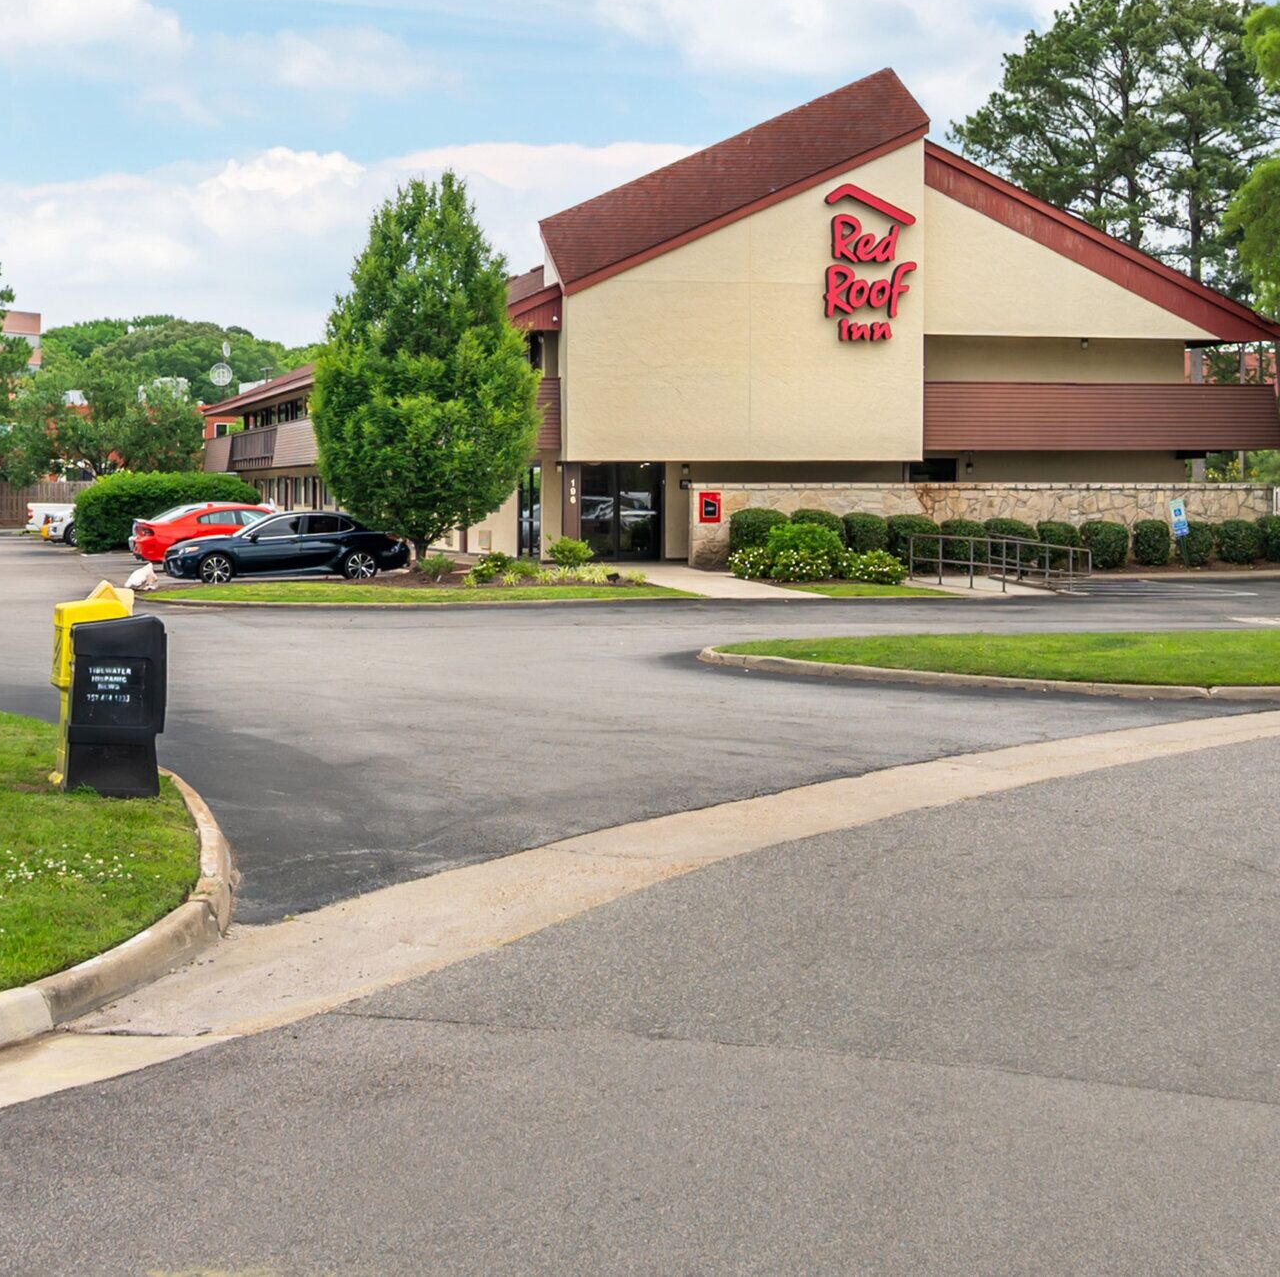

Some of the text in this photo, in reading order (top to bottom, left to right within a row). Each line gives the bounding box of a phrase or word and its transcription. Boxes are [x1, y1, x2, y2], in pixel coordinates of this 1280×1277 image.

[831, 213, 900, 264] Red
[823, 261, 918, 319] Roof
[838, 317, 893, 342] Inn
[91, 675, 128, 684] HISPANIC
